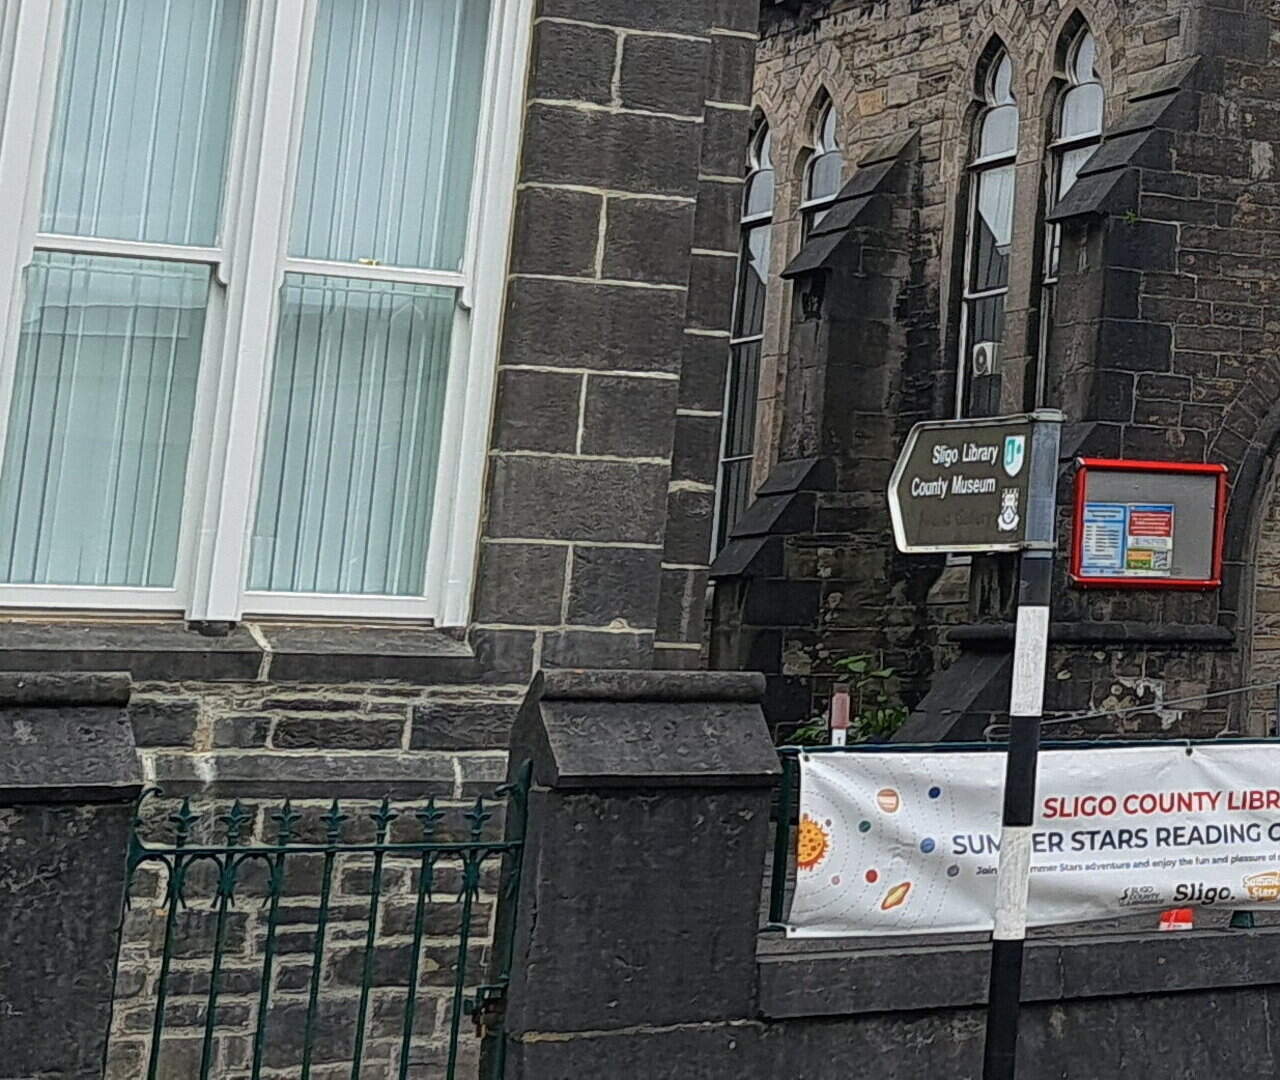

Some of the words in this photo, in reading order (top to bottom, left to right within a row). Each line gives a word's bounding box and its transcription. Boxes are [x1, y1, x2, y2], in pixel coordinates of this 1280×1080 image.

[932, 444, 958, 467] Sligo
[963, 443, 998, 466] Library
[911, 477, 947, 498] County
[951, 476, 996, 494] Museum
[1042, 795, 1118, 819] SLIGO
[1123, 790, 1222, 815] COUNTY
[952, 831, 1064, 855] SUMER
[1071, 828, 1149, 851] STARS
[1156, 823, 1261, 847] READING
[975, 865, 997, 876] Join
[1030, 864, 1058, 874] mmer
[1060, 862, 1083, 873] Stars
[1085, 861, 1131, 871] adventure
[1133, 860, 1150, 869] and
[1152, 858, 1176, 869] enjoy
[1179, 856, 1194, 866] the
[1195, 855, 1211, 865] fun
[1212, 855, 1229, 864] and
[1231, 853, 1267, 865] pleasure
[1268, 852, 1276, 862] of
